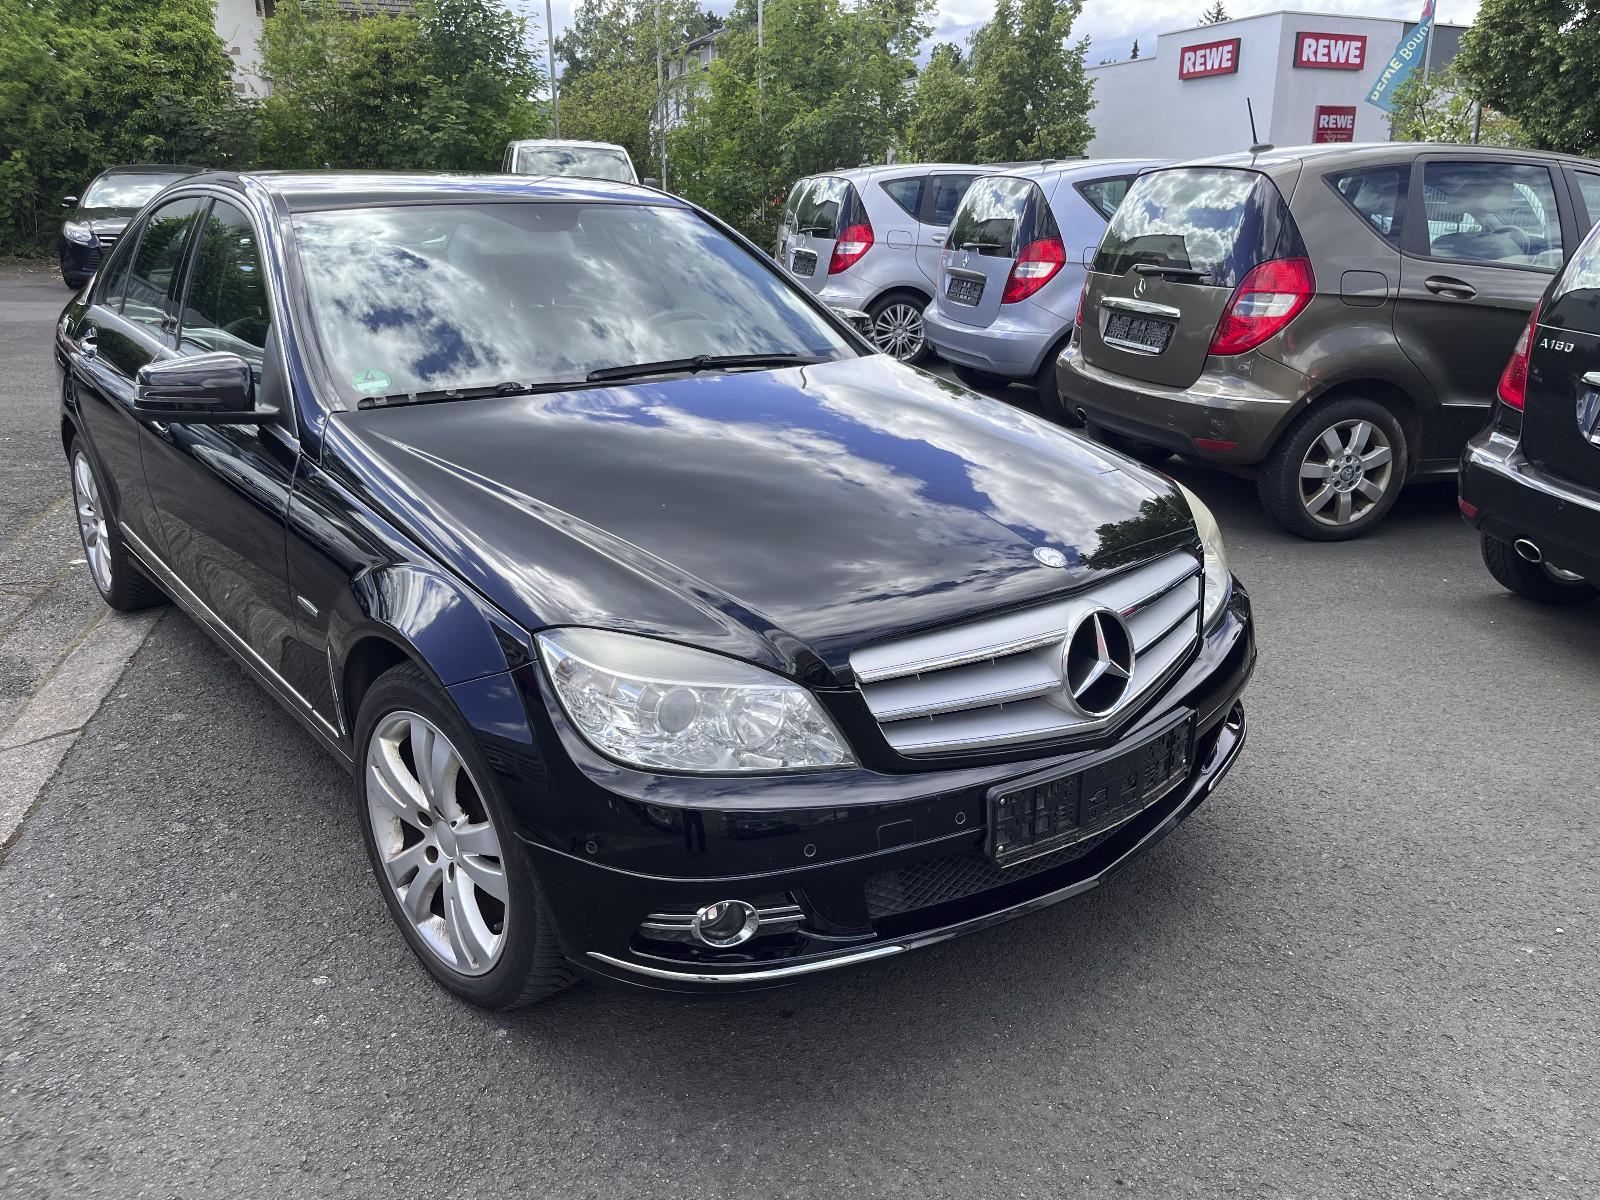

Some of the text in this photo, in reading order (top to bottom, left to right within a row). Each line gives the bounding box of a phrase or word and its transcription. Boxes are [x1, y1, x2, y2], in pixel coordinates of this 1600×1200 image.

[1183, 45, 1232, 74] REWE
[1302, 38, 1362, 64] REWE
[1319, 114, 1353, 129] REWE
